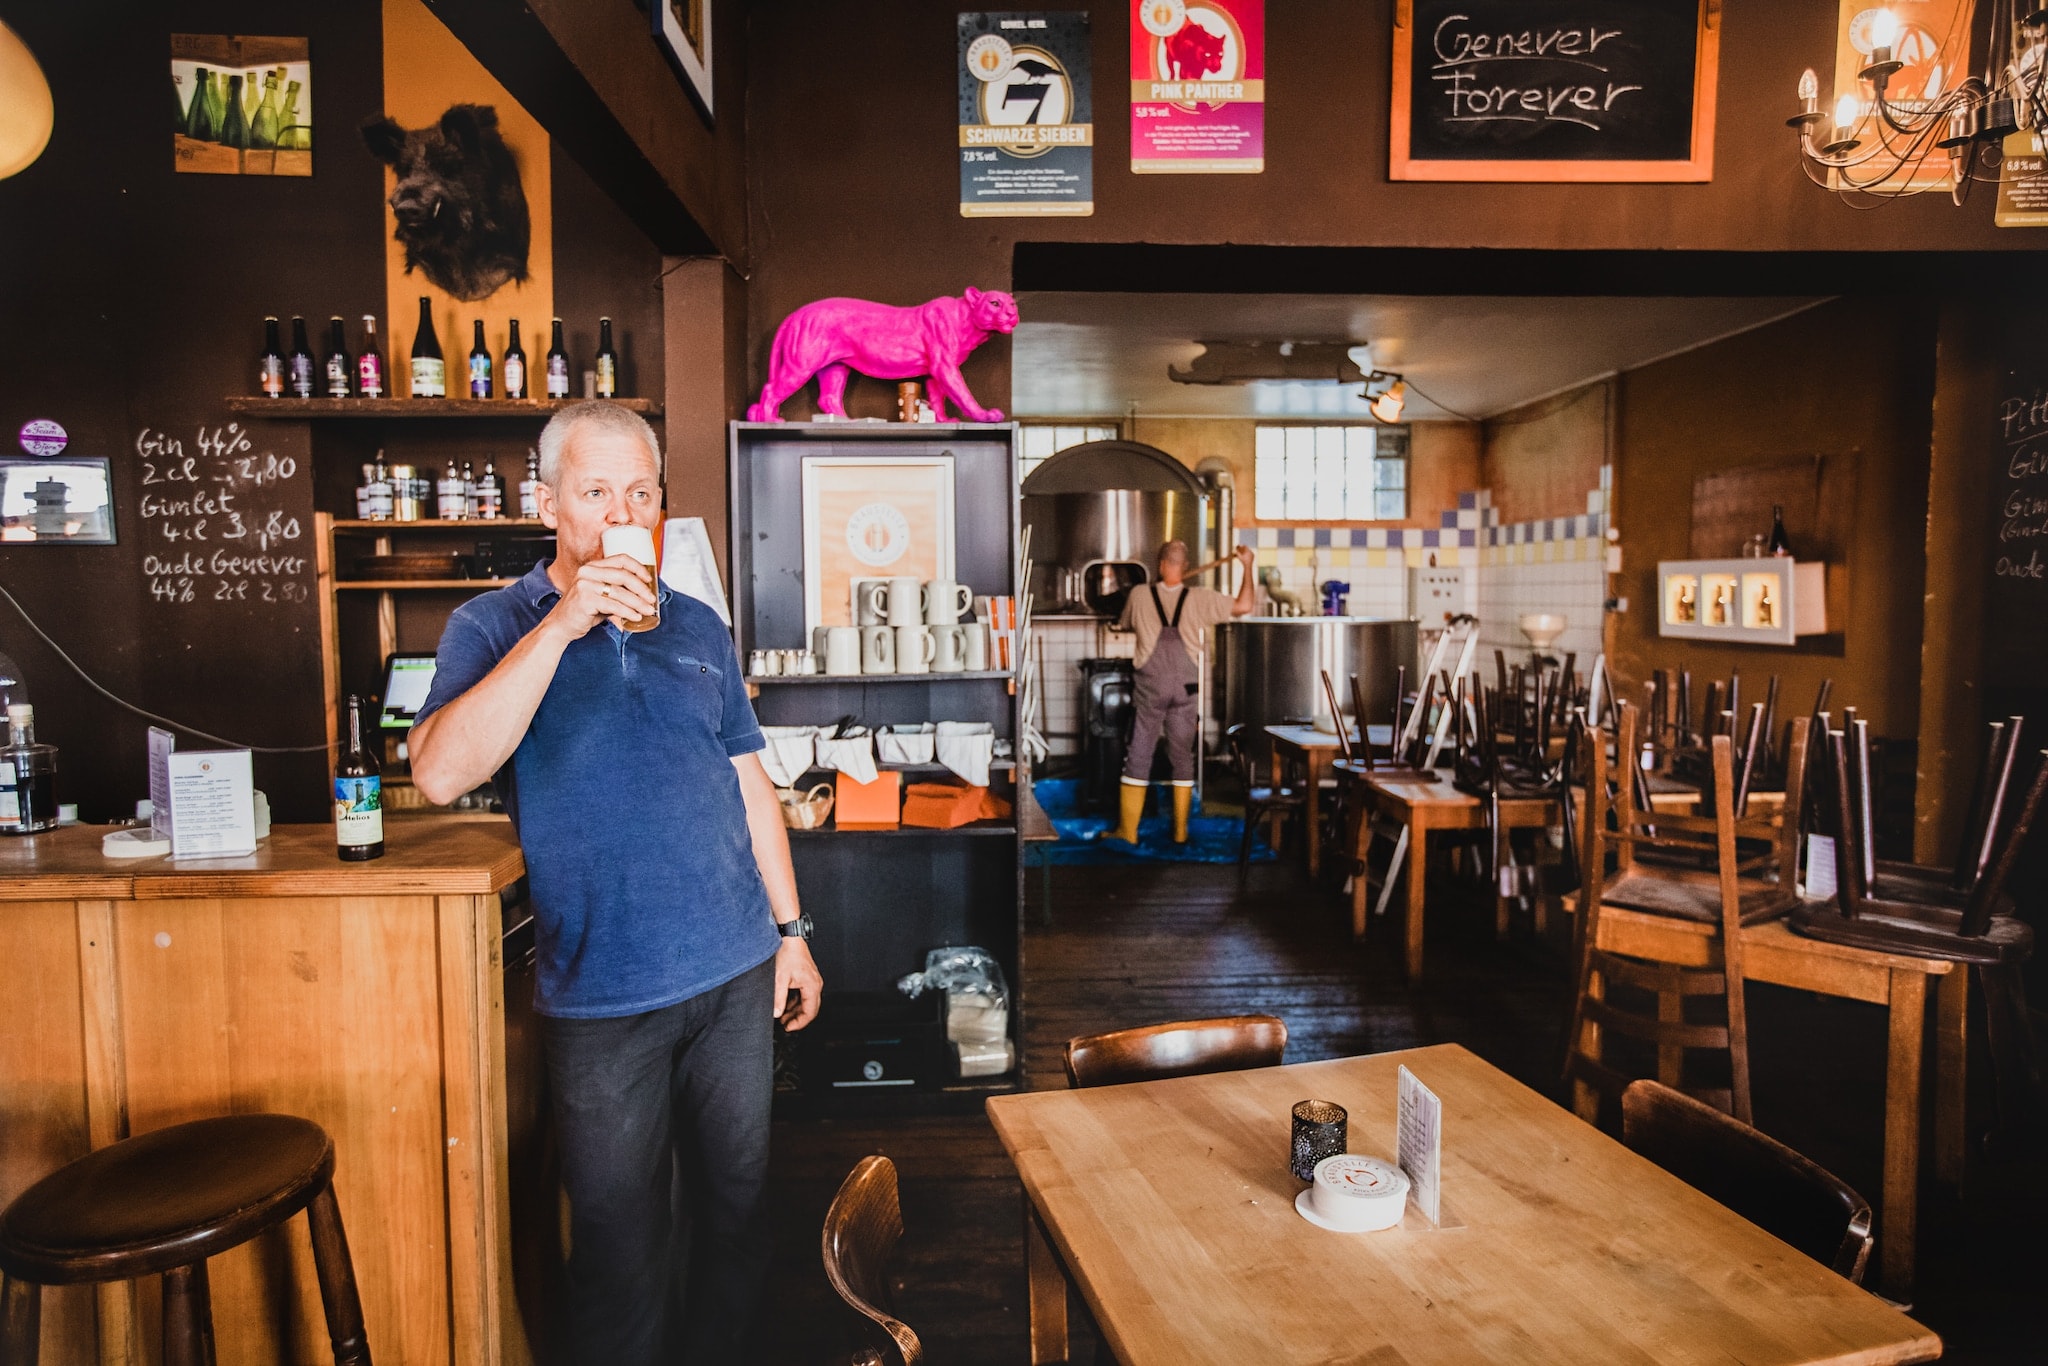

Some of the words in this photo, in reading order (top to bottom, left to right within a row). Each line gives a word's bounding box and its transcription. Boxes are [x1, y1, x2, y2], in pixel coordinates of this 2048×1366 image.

[1433, 14, 1622, 63] Genever
[1151, 84, 1182, 99] PINK
[1185, 84, 1243, 99] PANTHER
[1431, 69, 1643, 117] Forever
[966, 127, 1036, 144] SCHWARZE
[1038, 127, 1085, 143] SIEBEN
[2006, 160, 2019, 172] 6,8
[2020, 160, 2029, 171] %
[2029, 160, 2042, 171] vol.
[136, 428, 184, 457] Gin
[197, 422, 252, 457] 44%
[139, 487, 235, 518] Gimlet
[143, 552, 206, 576] Oude
[210, 548, 306, 577] Genever
[151, 577, 196, 603] 44%
